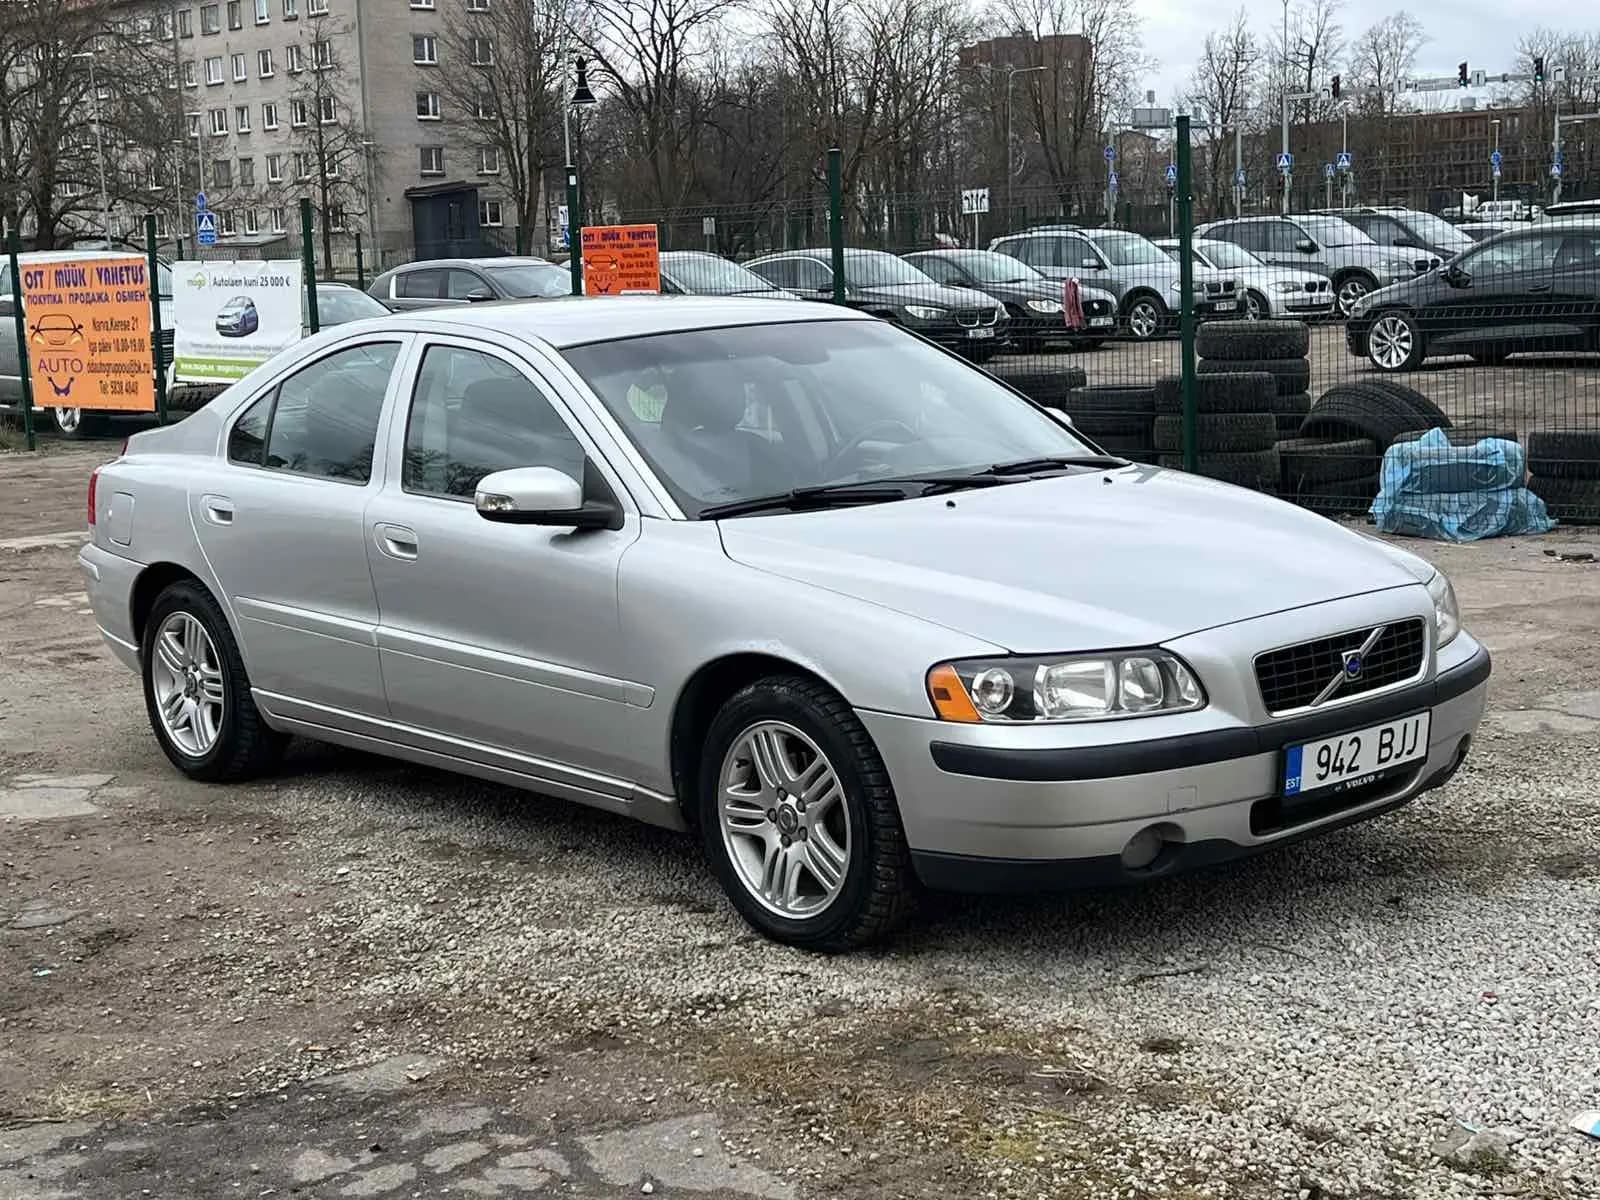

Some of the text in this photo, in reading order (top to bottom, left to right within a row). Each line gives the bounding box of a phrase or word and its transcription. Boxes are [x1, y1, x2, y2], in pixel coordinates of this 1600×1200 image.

[25, 270, 44, 289] OST
[55, 264, 86, 288] MÜÜK
[96, 264, 144, 286] VAHETUS
[213, 276, 242, 287] Autolaen
[244, 276, 259, 287] kuni
[260, 276, 269, 287] 25
[270, 276, 284, 287] 000
[27, 294, 63, 305] ПОКУПКА
[69, 292, 109, 304] ПРОДАЖА
[116, 290, 146, 303] ОБМЕН
[38, 358, 83, 373] AUTO
[1316, 720, 1419, 781] 942 BJJ
[1286, 776, 1301, 790] EST
[1346, 775, 1375, 789] VOLVO
